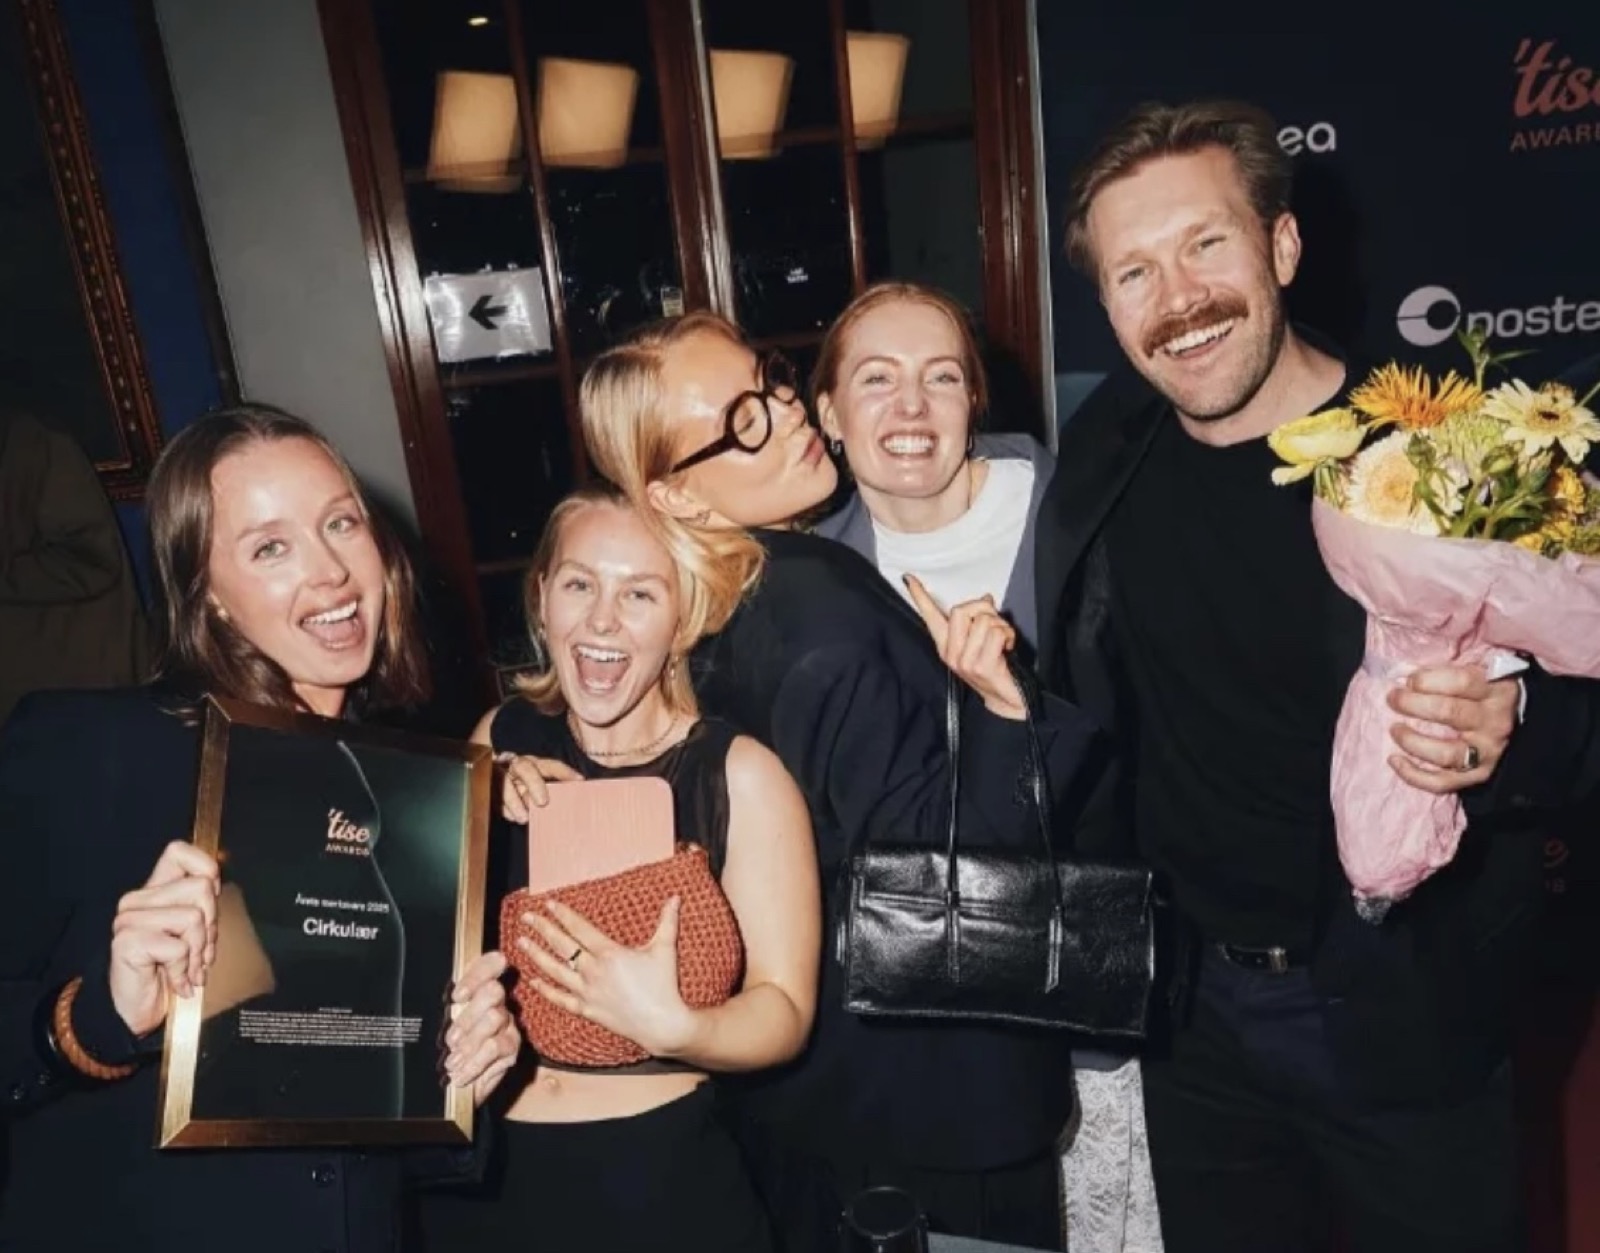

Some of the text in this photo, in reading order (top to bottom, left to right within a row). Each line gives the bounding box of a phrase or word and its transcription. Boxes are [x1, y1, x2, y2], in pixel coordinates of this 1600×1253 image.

[1513, 38, 1600, 117] 'tis
[1276, 122, 1337, 156] ea
[303, 916, 380, 940] Cirkulær
